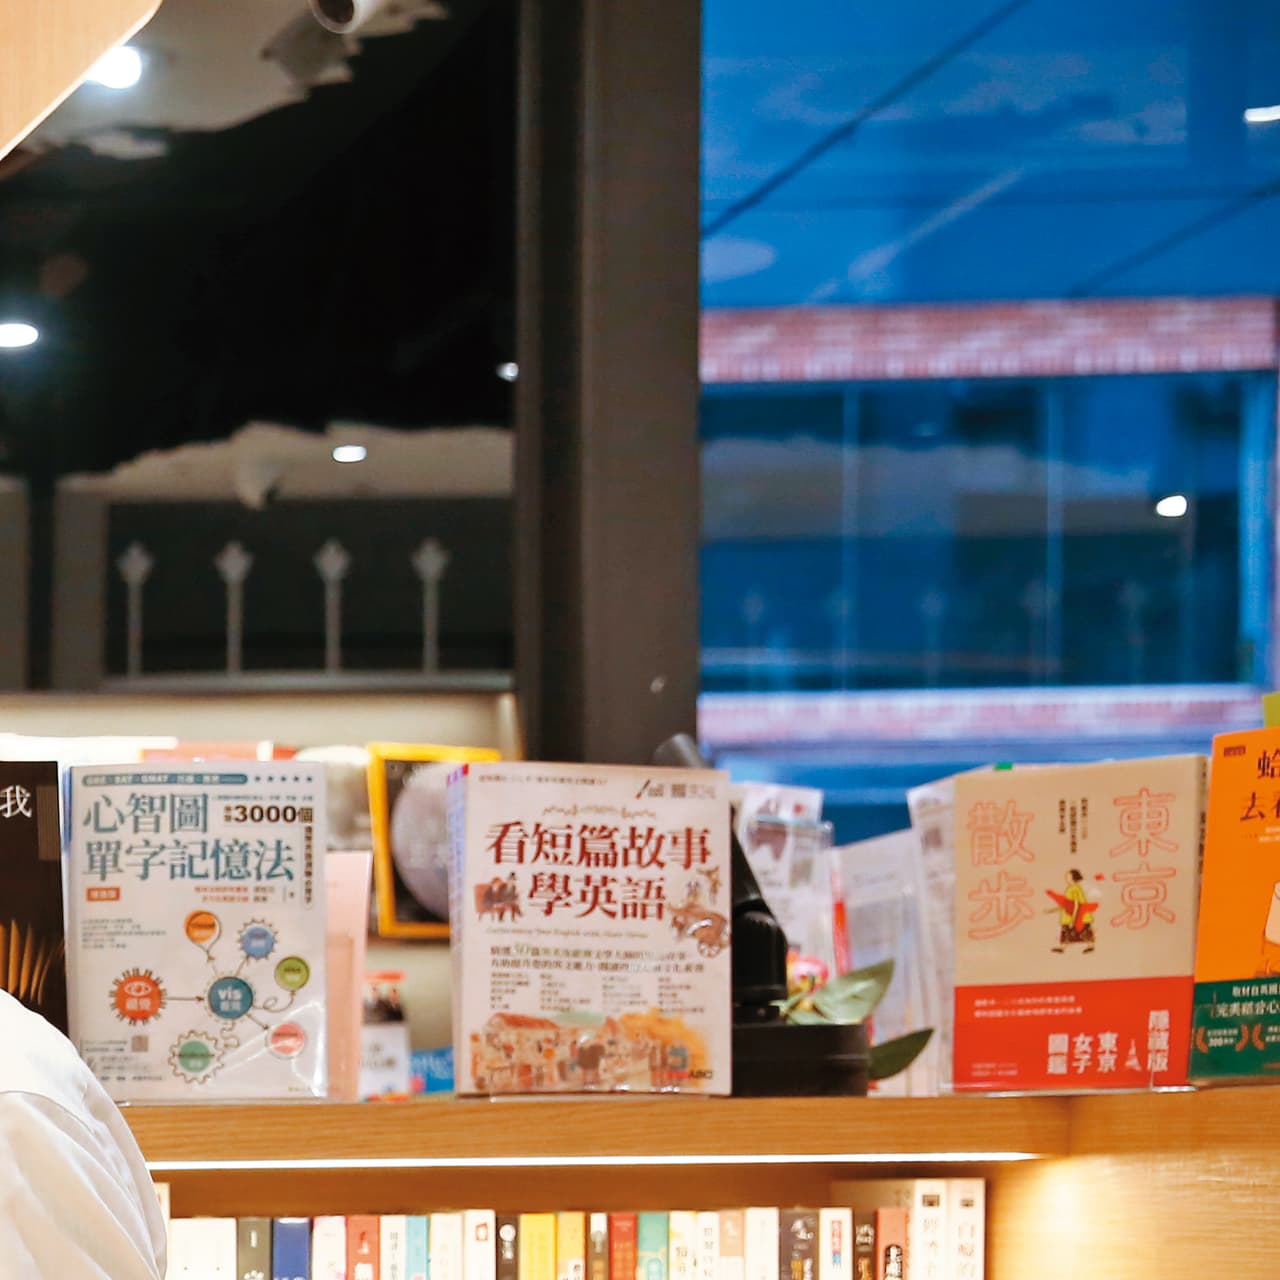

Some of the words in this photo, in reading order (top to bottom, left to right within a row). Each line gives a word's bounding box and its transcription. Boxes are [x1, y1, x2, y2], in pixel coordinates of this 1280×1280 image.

[82, 792, 209, 834] 心智圖
[82, 838, 295, 881] 單字記憶法
[488, 821, 711, 869] 看短篇故事
[1109, 787, 1178, 930] 東京
[967, 801, 1035, 940] 散步
[528, 872, 667, 920] 學英語
[1072, 1032, 1094, 1074] 女子
[1097, 1031, 1118, 1072] 東京
